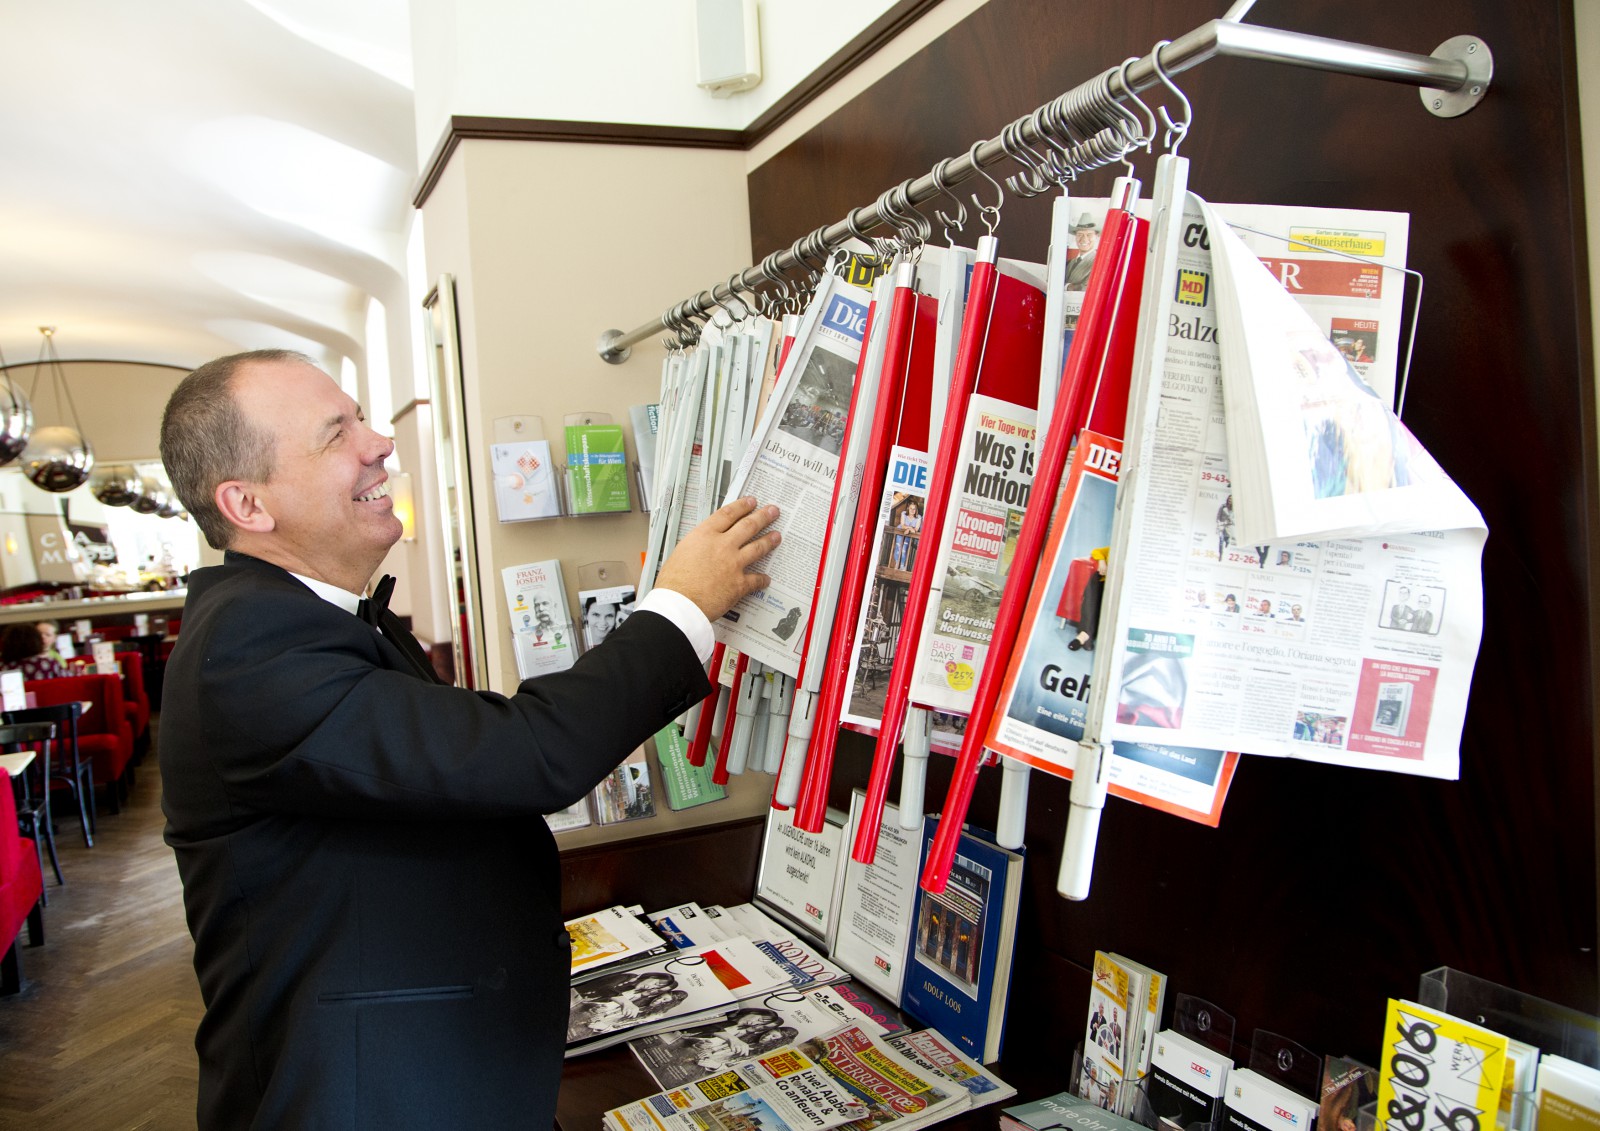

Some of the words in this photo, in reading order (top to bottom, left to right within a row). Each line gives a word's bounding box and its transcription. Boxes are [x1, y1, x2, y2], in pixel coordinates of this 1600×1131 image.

[1184, 222, 1211, 250] CO
[1302, 235, 1373, 250] Schweizerhaus
[1181, 280, 1203, 294] MD
[830, 301, 868, 336] Die
[1354, 321, 1377, 330] HEUTE
[818, 326, 832, 336] SEIT
[833, 331, 849, 342] 1848
[1175, 382, 1208, 394] GOVERNO
[981, 414, 996, 429] Vier
[998, 416, 1016, 434] Tage
[1017, 426, 1030, 438] vor
[1212, 415, 1225, 425] MIL
[765, 439, 801, 464] Libyen
[803, 459, 823, 475] will
[823, 466, 838, 483] Mi
[974, 431, 1016, 470] Was
[1084, 443, 1121, 475] DE
[893, 461, 927, 490] DIE
[964, 463, 1031, 508] Nation
[1199, 491, 1218, 500] ROMA
[957, 511, 1004, 537] Kronen
[954, 528, 1000, 555] Zeitung
[515, 575, 546, 586] JOSEPH
[517, 568, 543, 579] FRANZ
[943, 607, 996, 631] Österreich
[940, 621, 993, 642] Hochwasse
[930, 650, 955, 661] DAYS
[932, 640, 957, 651] BABY
[1323, 655, 1357, 667] segreta
[1040, 664, 1091, 704] Geh
[1037, 705, 1052, 717] Eine
[1053, 713, 1068, 723] eitle
[1069, 717, 1086, 728] Fein
[1071, 708, 1084, 717] Die
[1181, 754, 1197, 765] Land
[611, 907, 624, 918] NEWS
[772, 940, 836, 982] RONDO
[923, 980, 944, 1000] ADOLF
[944, 992, 962, 1014] LOOS
[855, 1031, 868, 1044] WIEN
[901, 1046, 917, 1063] bin
[912, 1032, 954, 1067] Heute
[1452, 1040, 1464, 1071] WERK
[767, 1056, 793, 1074] BLATT
[780, 1052, 803, 1071] BEZIRKS
[829, 1039, 901, 1101] ÖSTERREICH
[801, 1070, 828, 1089] Live!
[820, 1089, 849, 1116] Alaba,
[1325, 1086, 1335, 1094] The
[1334, 1077, 1349, 1089] Magic
[1349, 1070, 1362, 1080] Flute
[775, 1080, 789, 1091] Co
[785, 1090, 825, 1126] anfeuern
[820, 1107, 834, 1116] &
[1039, 1100, 1076, 1118] more
[1077, 1114, 1107, 1131] ohr
